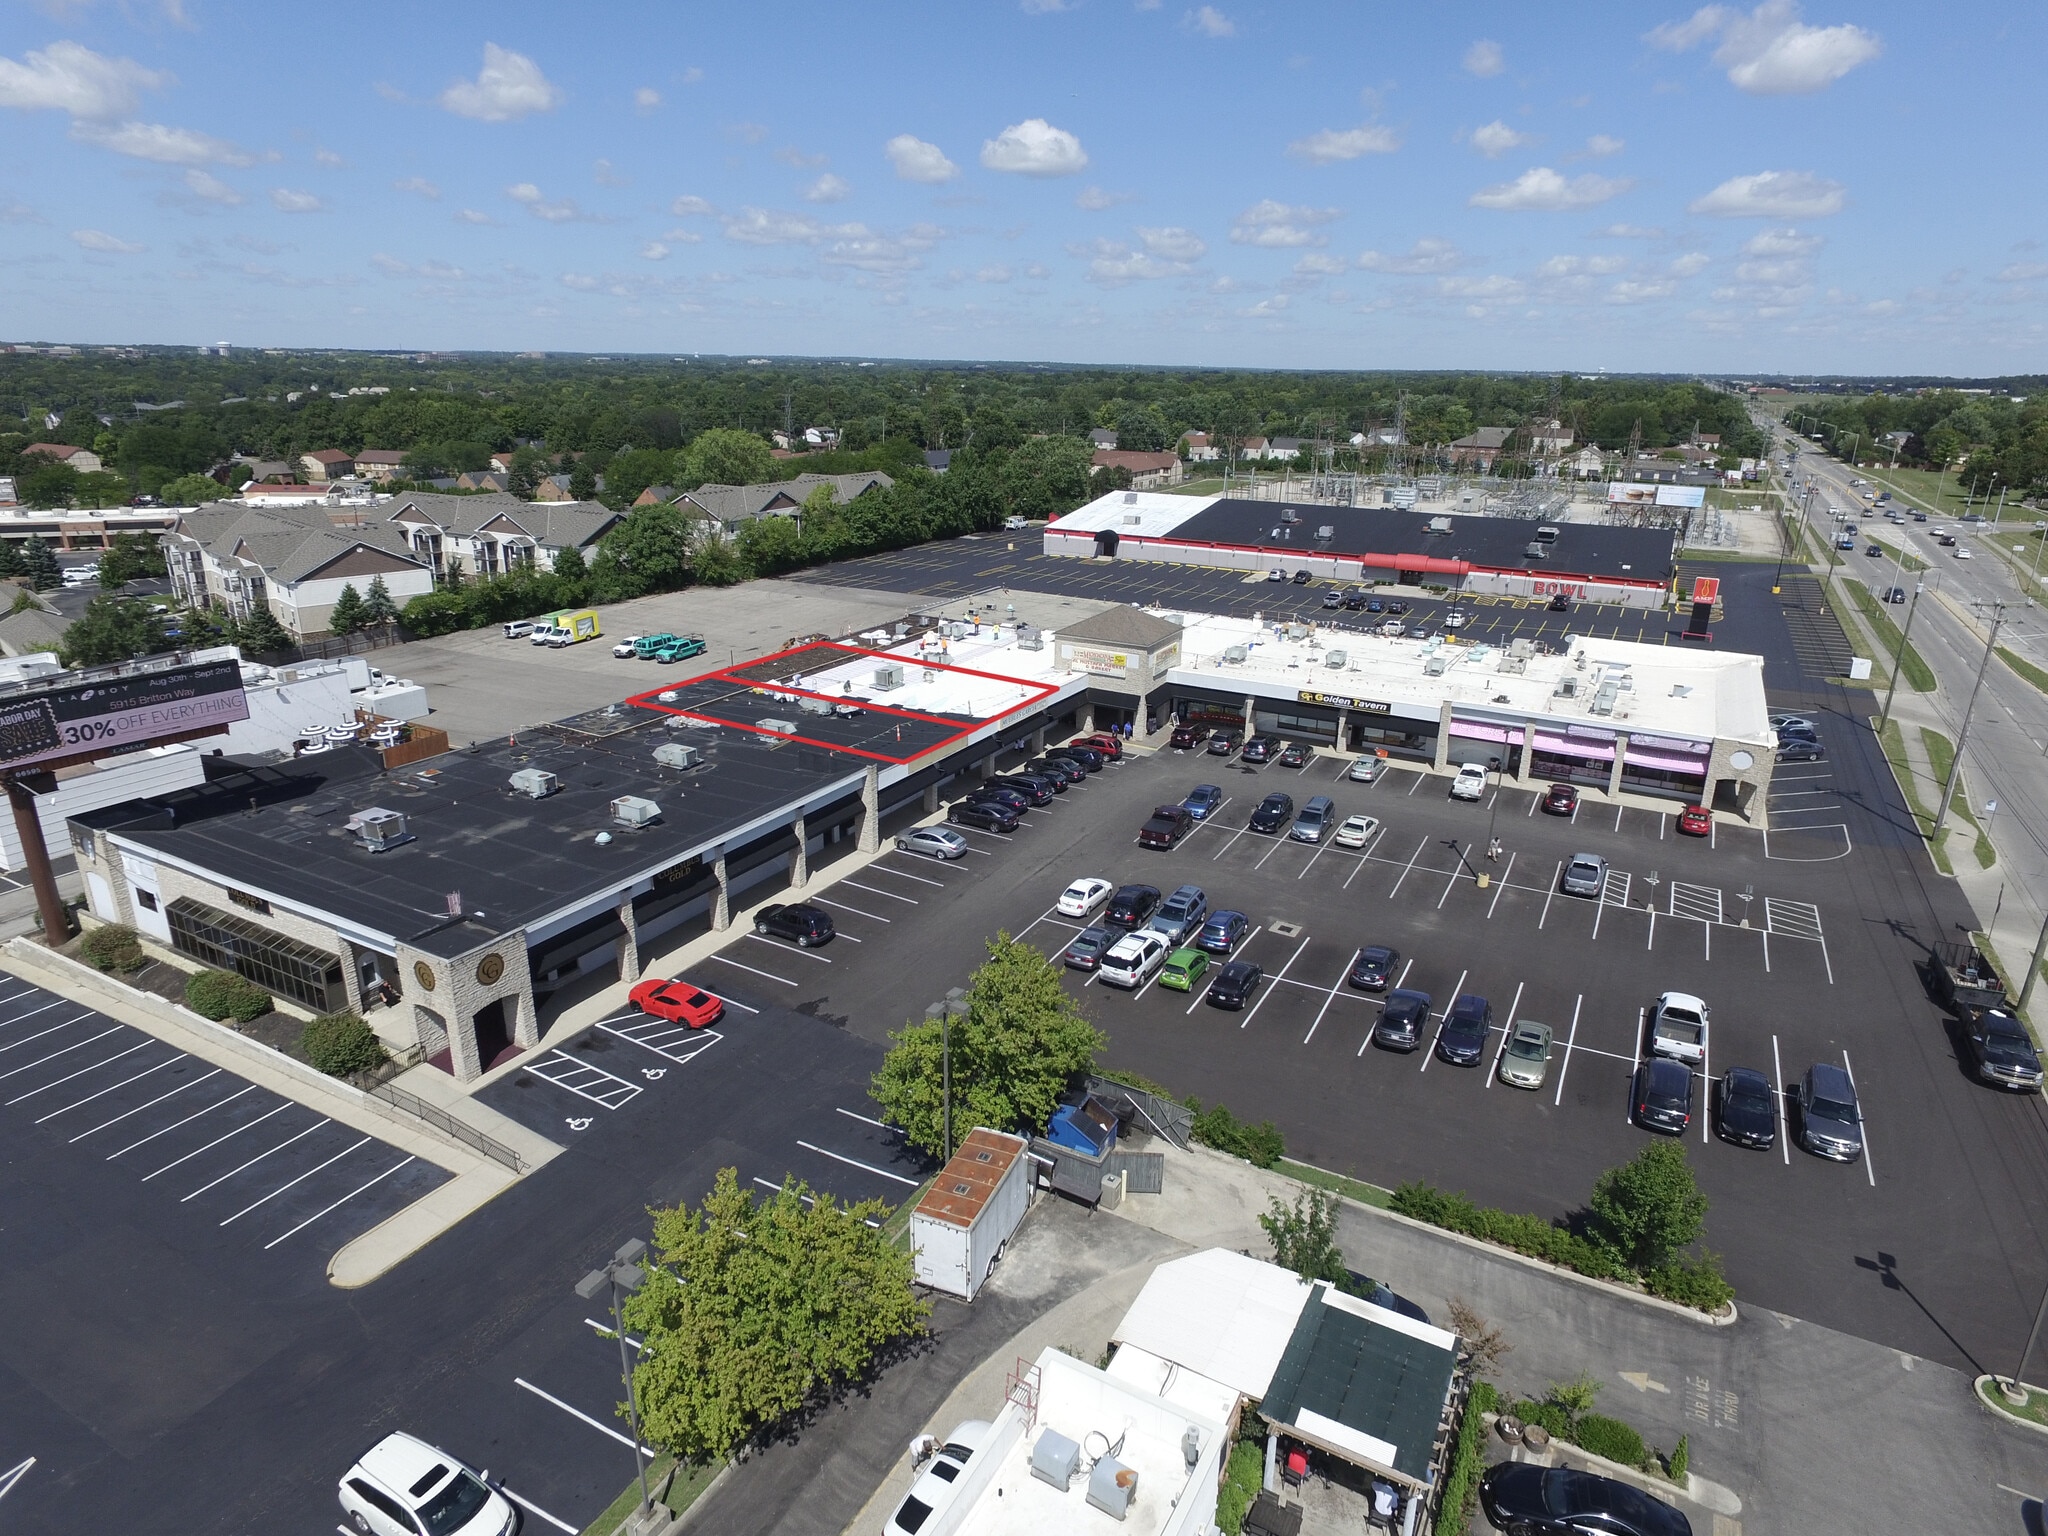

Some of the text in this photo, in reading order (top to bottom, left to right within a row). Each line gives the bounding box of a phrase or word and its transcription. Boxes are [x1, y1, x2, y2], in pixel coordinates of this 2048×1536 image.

[1533, 581, 1587, 599] BOWL
[150, 679, 167, 687] Aug
[168, 674, 187, 684] 30th
[194, 670, 214, 679] Sept
[215, 666, 231, 675] 2nd
[110, 687, 196, 710] 5915 Britton Way
[1314, 693, 1351, 706] Golden
[1352, 699, 1388, 711] Tavern
[0, 708, 41, 729] ABOR DAY
[64, 695, 243, 745] 30% OFF EVERYTHING
[669, 867, 691, 882] GOLD
